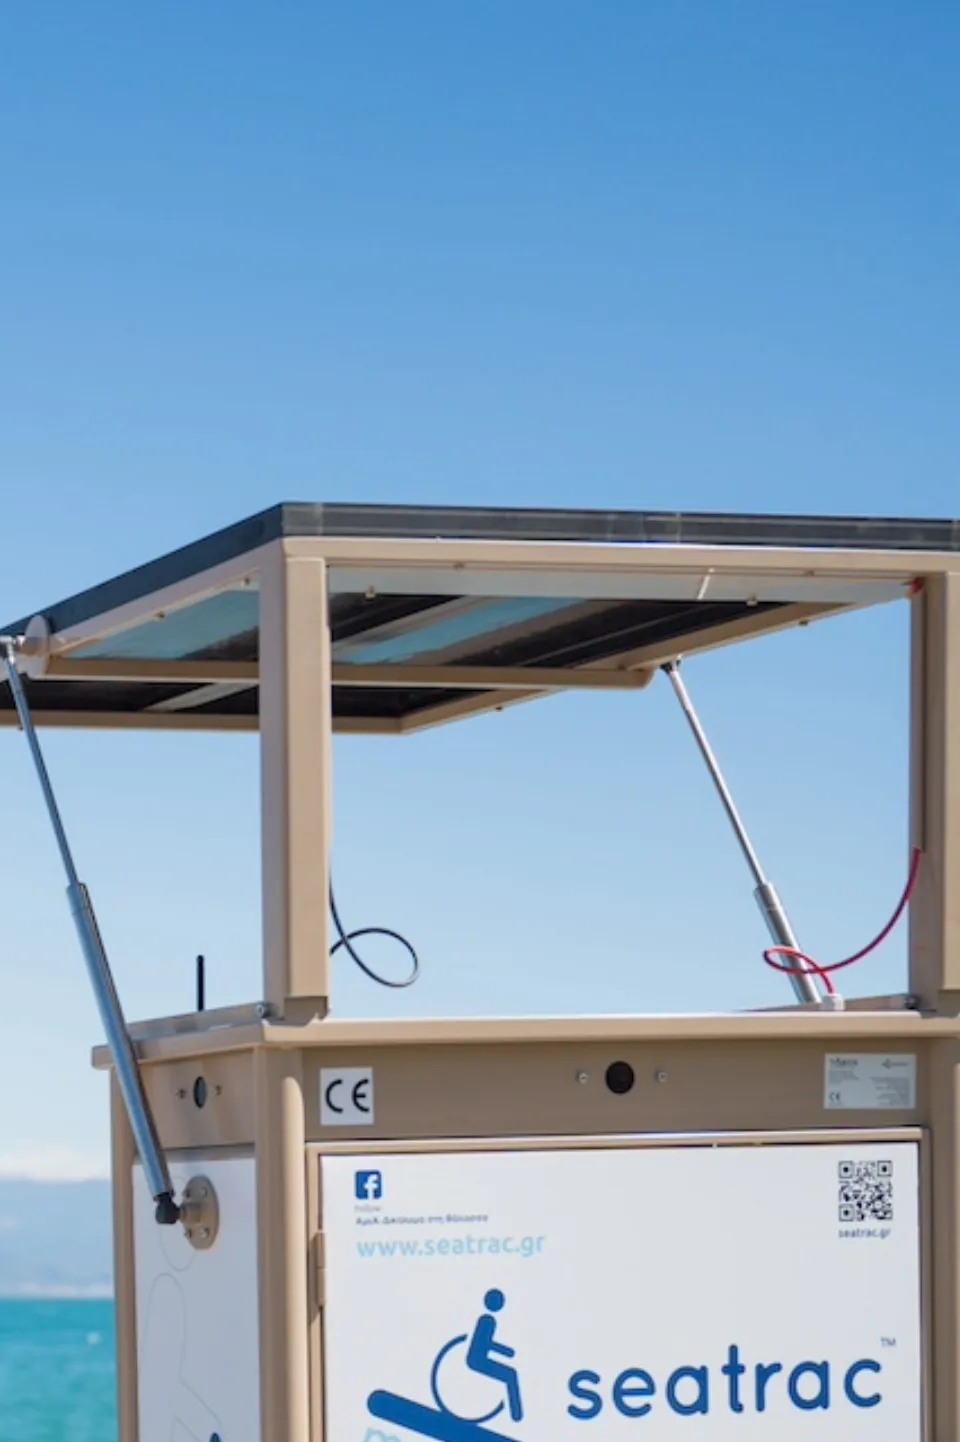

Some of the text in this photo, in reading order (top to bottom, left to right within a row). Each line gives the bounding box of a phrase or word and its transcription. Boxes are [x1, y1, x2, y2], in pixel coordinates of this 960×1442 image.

[325, 1078, 370, 1114] CE
[356, 1233, 546, 1259] www.seatrac.gr
[837, 1226, 893, 1241] seatrac.gr
[566, 1344, 882, 1421] seatrac
